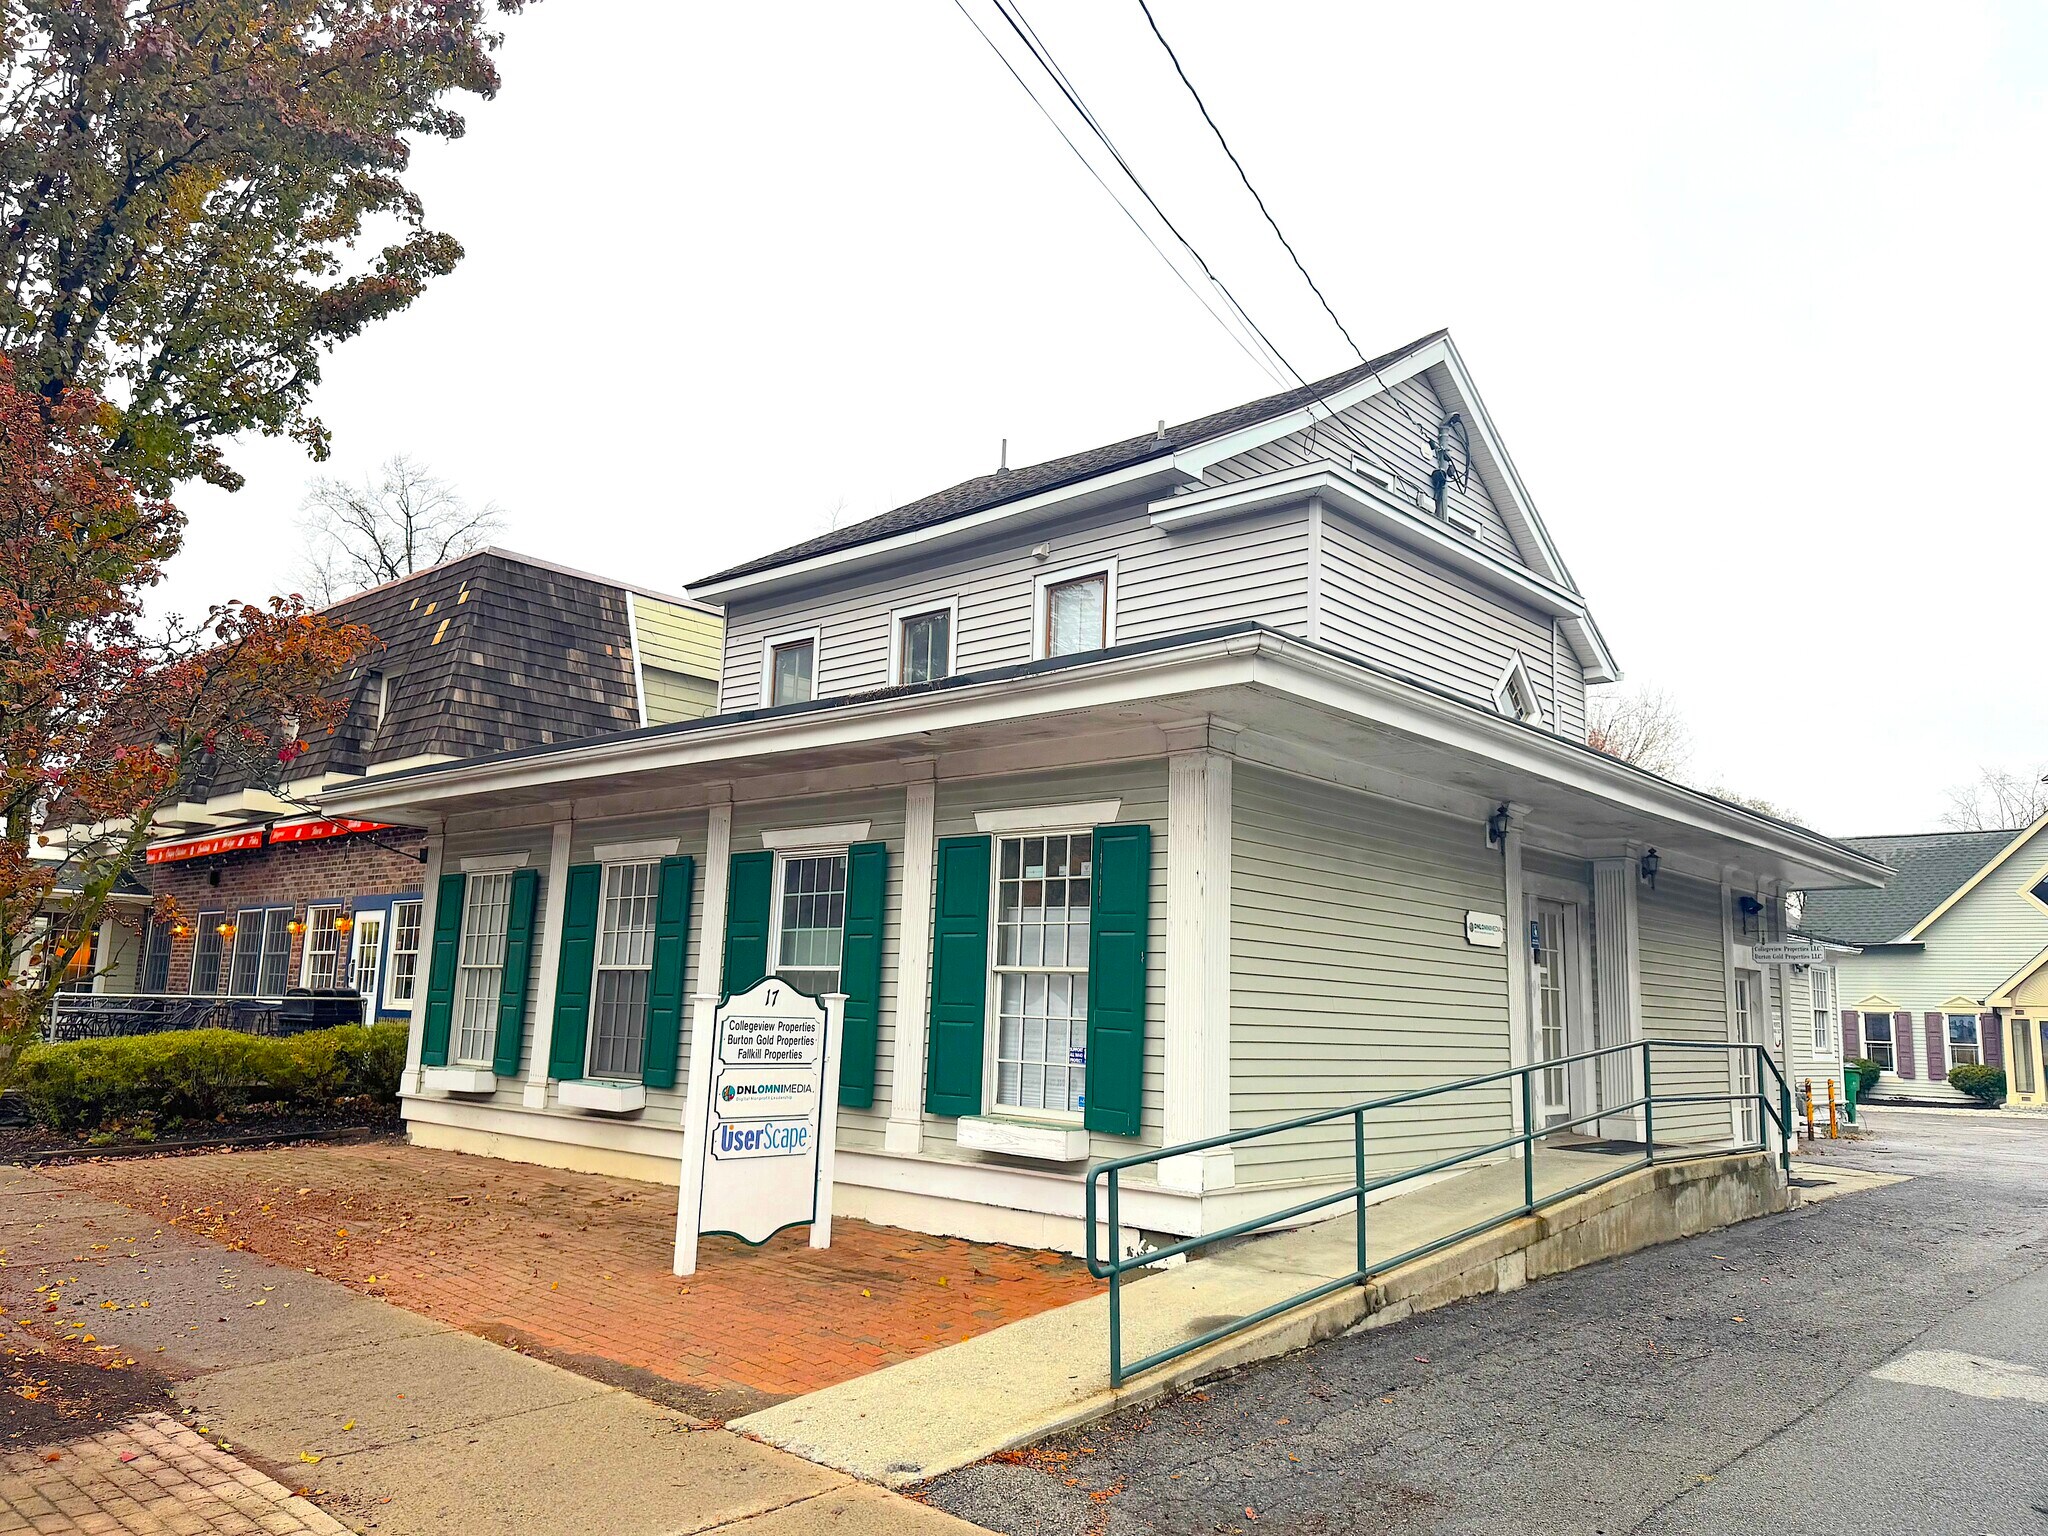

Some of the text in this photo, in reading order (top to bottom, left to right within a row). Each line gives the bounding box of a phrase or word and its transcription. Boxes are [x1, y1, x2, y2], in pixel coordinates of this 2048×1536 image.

[1784, 945, 1809, 953] Properties
[765, 989, 780, 1007] 17
[729, 1020, 816, 1033] Collegeview Properties
[727, 1034, 815, 1047] Burton Gold Properties
[738, 1048, 803, 1061] Fallkill Properties
[736, 1084, 812, 1095] DNLOMNIMEDIA
[721, 1123, 807, 1154] UserScape
